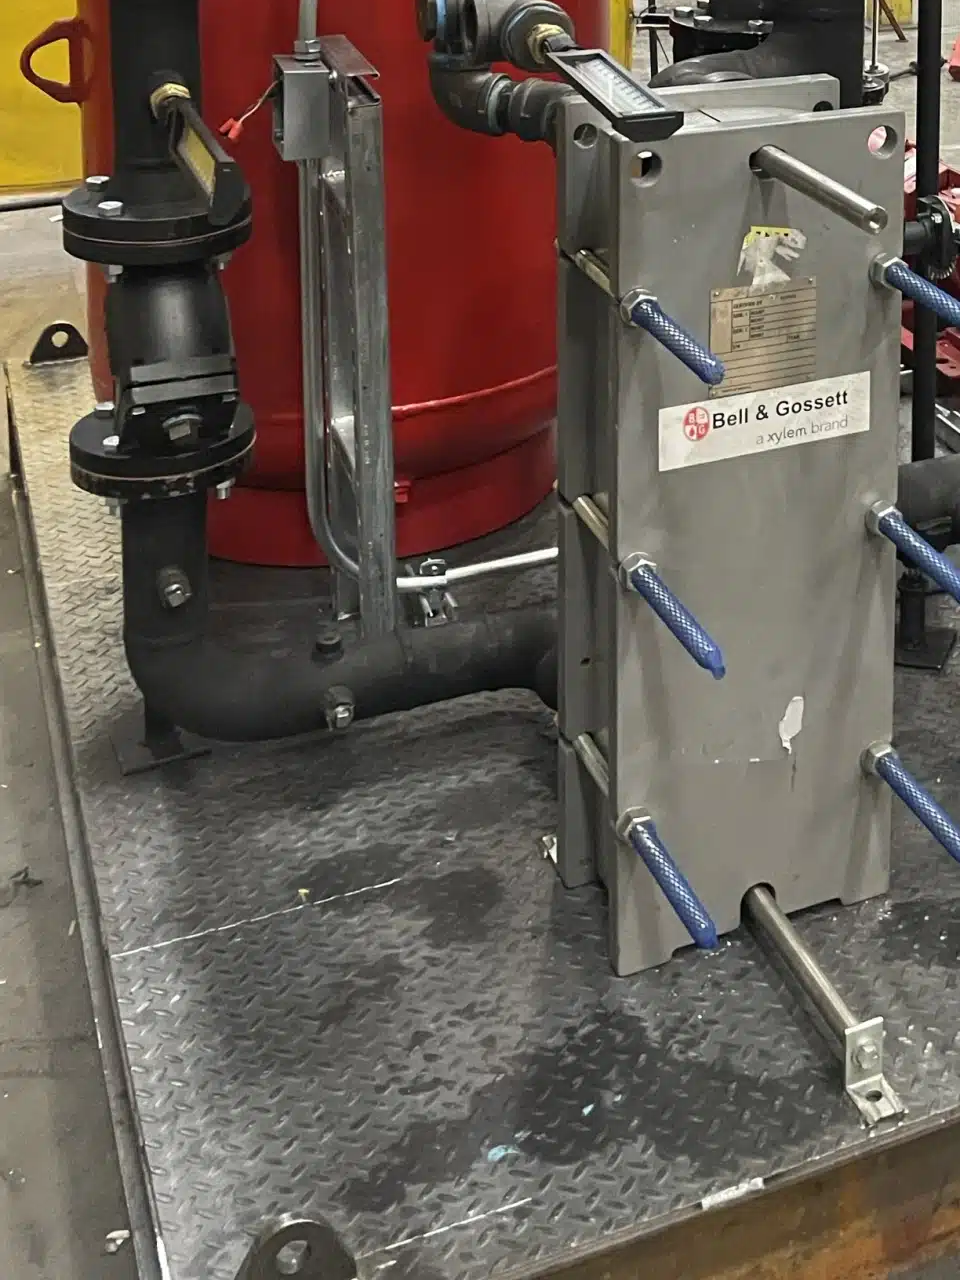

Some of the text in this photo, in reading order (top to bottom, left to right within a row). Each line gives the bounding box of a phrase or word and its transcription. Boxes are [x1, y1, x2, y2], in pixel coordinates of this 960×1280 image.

[712, 390, 848, 429] Bell & Gossett
[756, 415, 849, 446] a xylem brand
